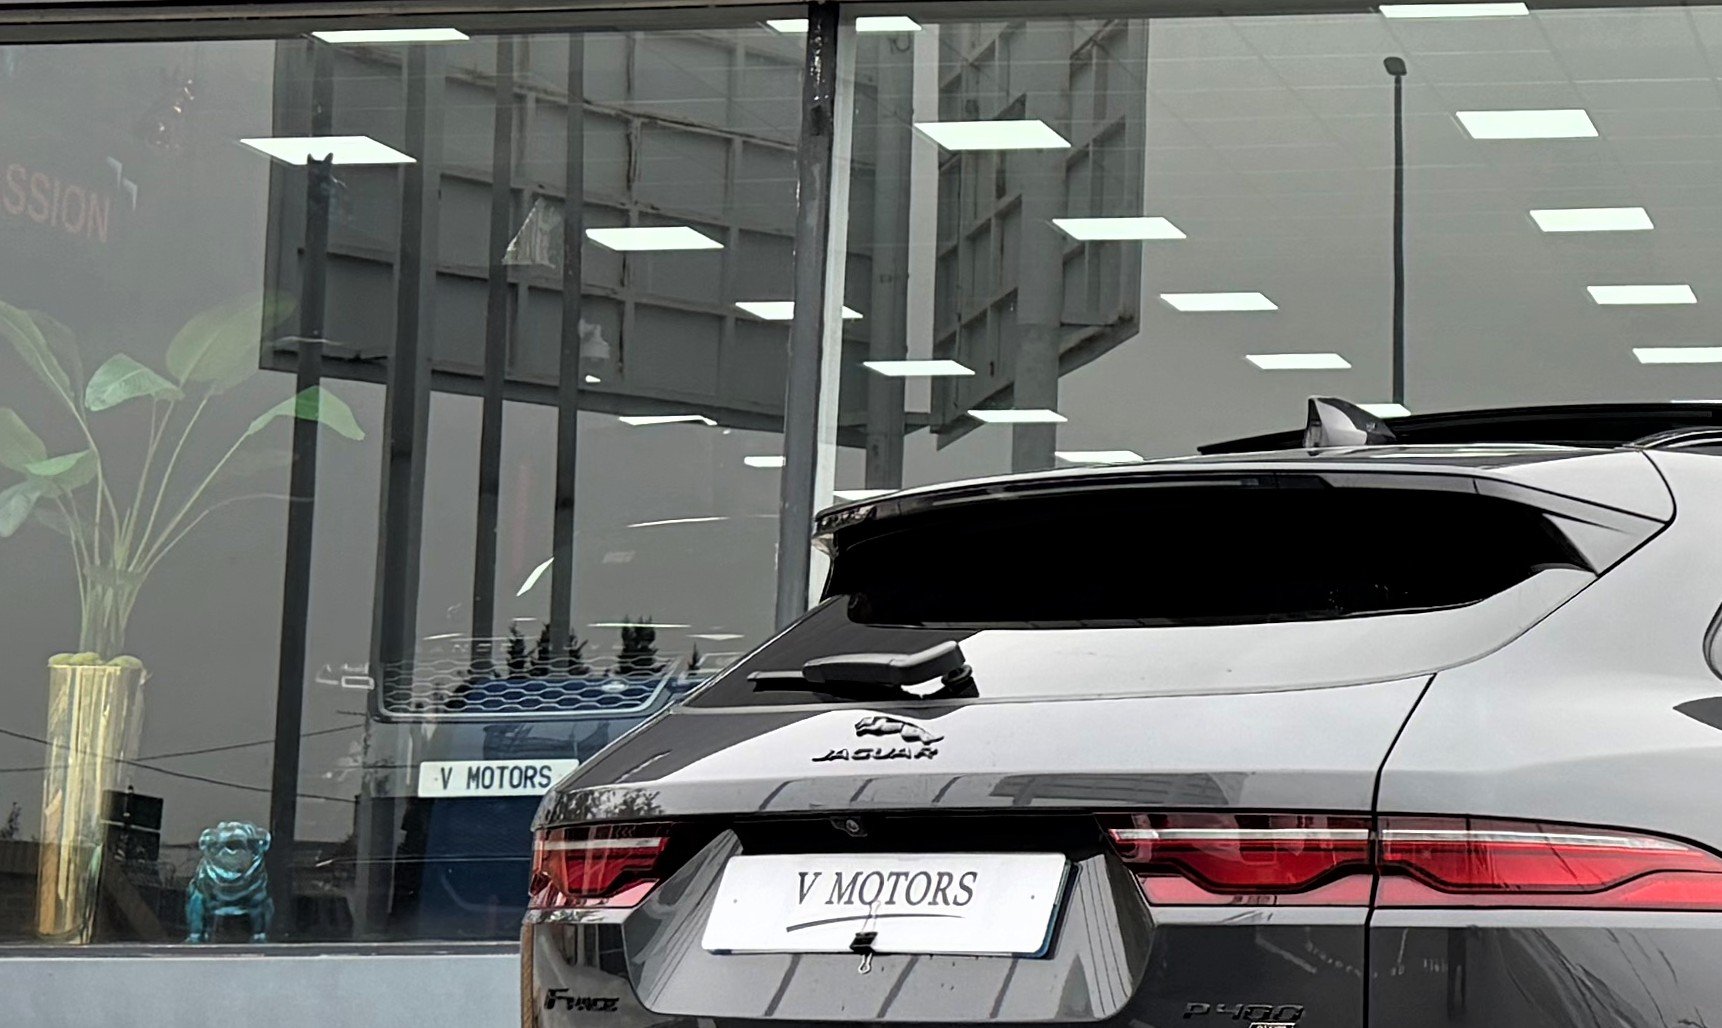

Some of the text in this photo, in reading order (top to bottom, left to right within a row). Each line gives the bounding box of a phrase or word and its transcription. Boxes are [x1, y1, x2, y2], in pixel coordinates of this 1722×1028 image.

[811, 748, 939, 762] JAGUAR
[440, 765, 553, 790] V MOTORS
[797, 870, 979, 906] V MOTORS
